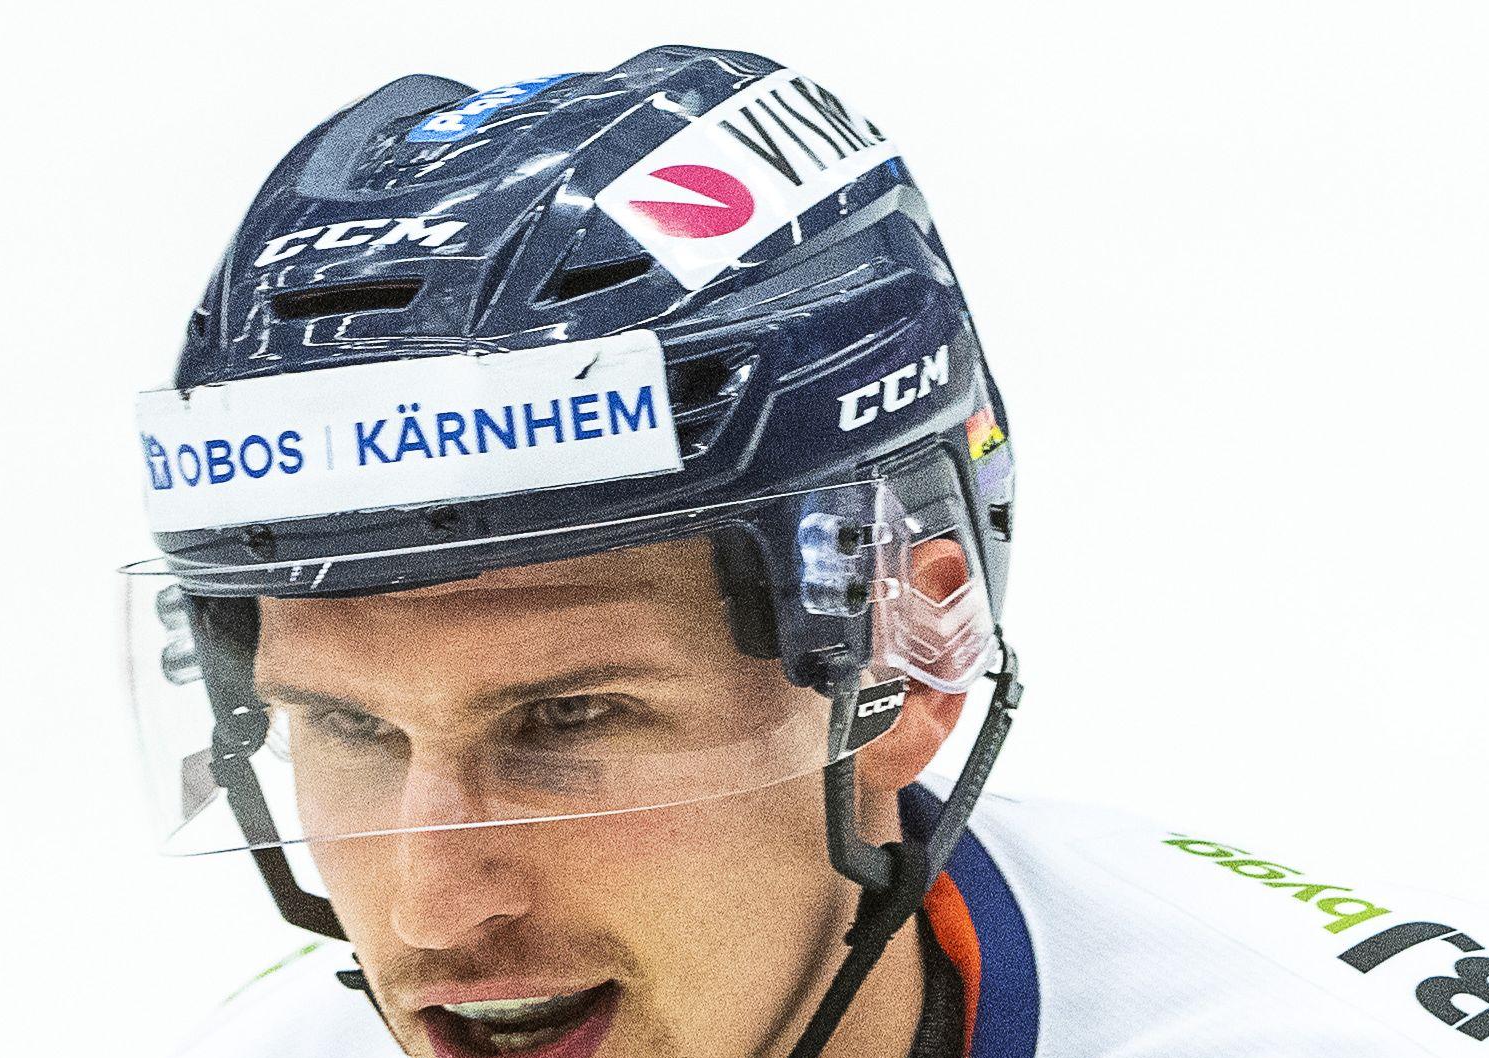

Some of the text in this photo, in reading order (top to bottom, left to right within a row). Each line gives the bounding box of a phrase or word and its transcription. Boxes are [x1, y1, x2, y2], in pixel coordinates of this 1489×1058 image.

[254, 216, 468, 269] CCM
[177, 384, 658, 488] OBOS KÄRNHEM
[837, 344, 950, 433] CCM
[1161, 832, 1393, 935] bygg
